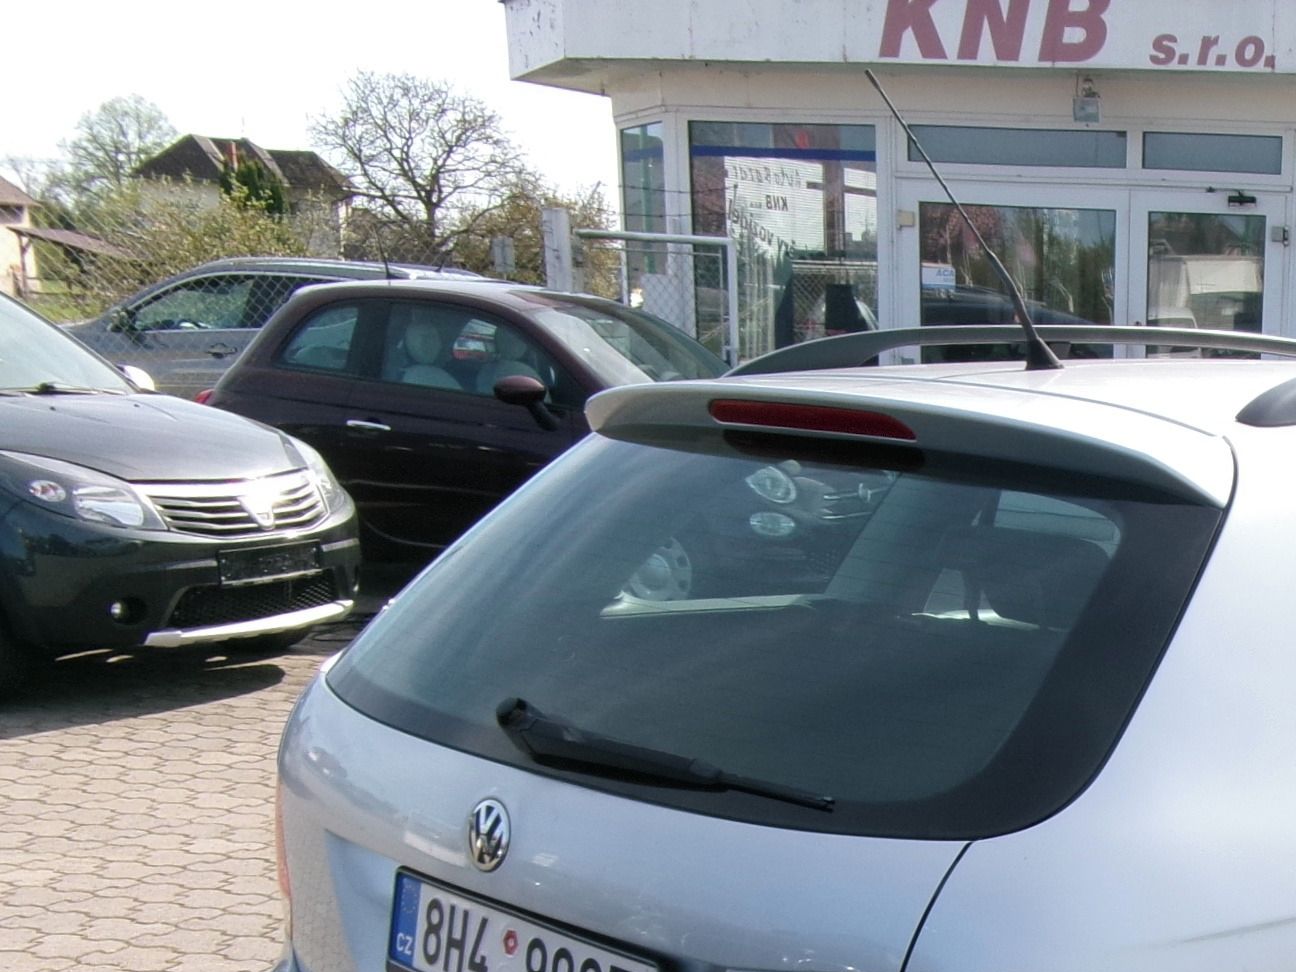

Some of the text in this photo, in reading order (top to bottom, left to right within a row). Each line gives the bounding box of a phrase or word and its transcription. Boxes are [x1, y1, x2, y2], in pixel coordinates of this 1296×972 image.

[878, 0, 1277, 68] KNB s.r.o.
[396, 932, 413, 955] CZ
